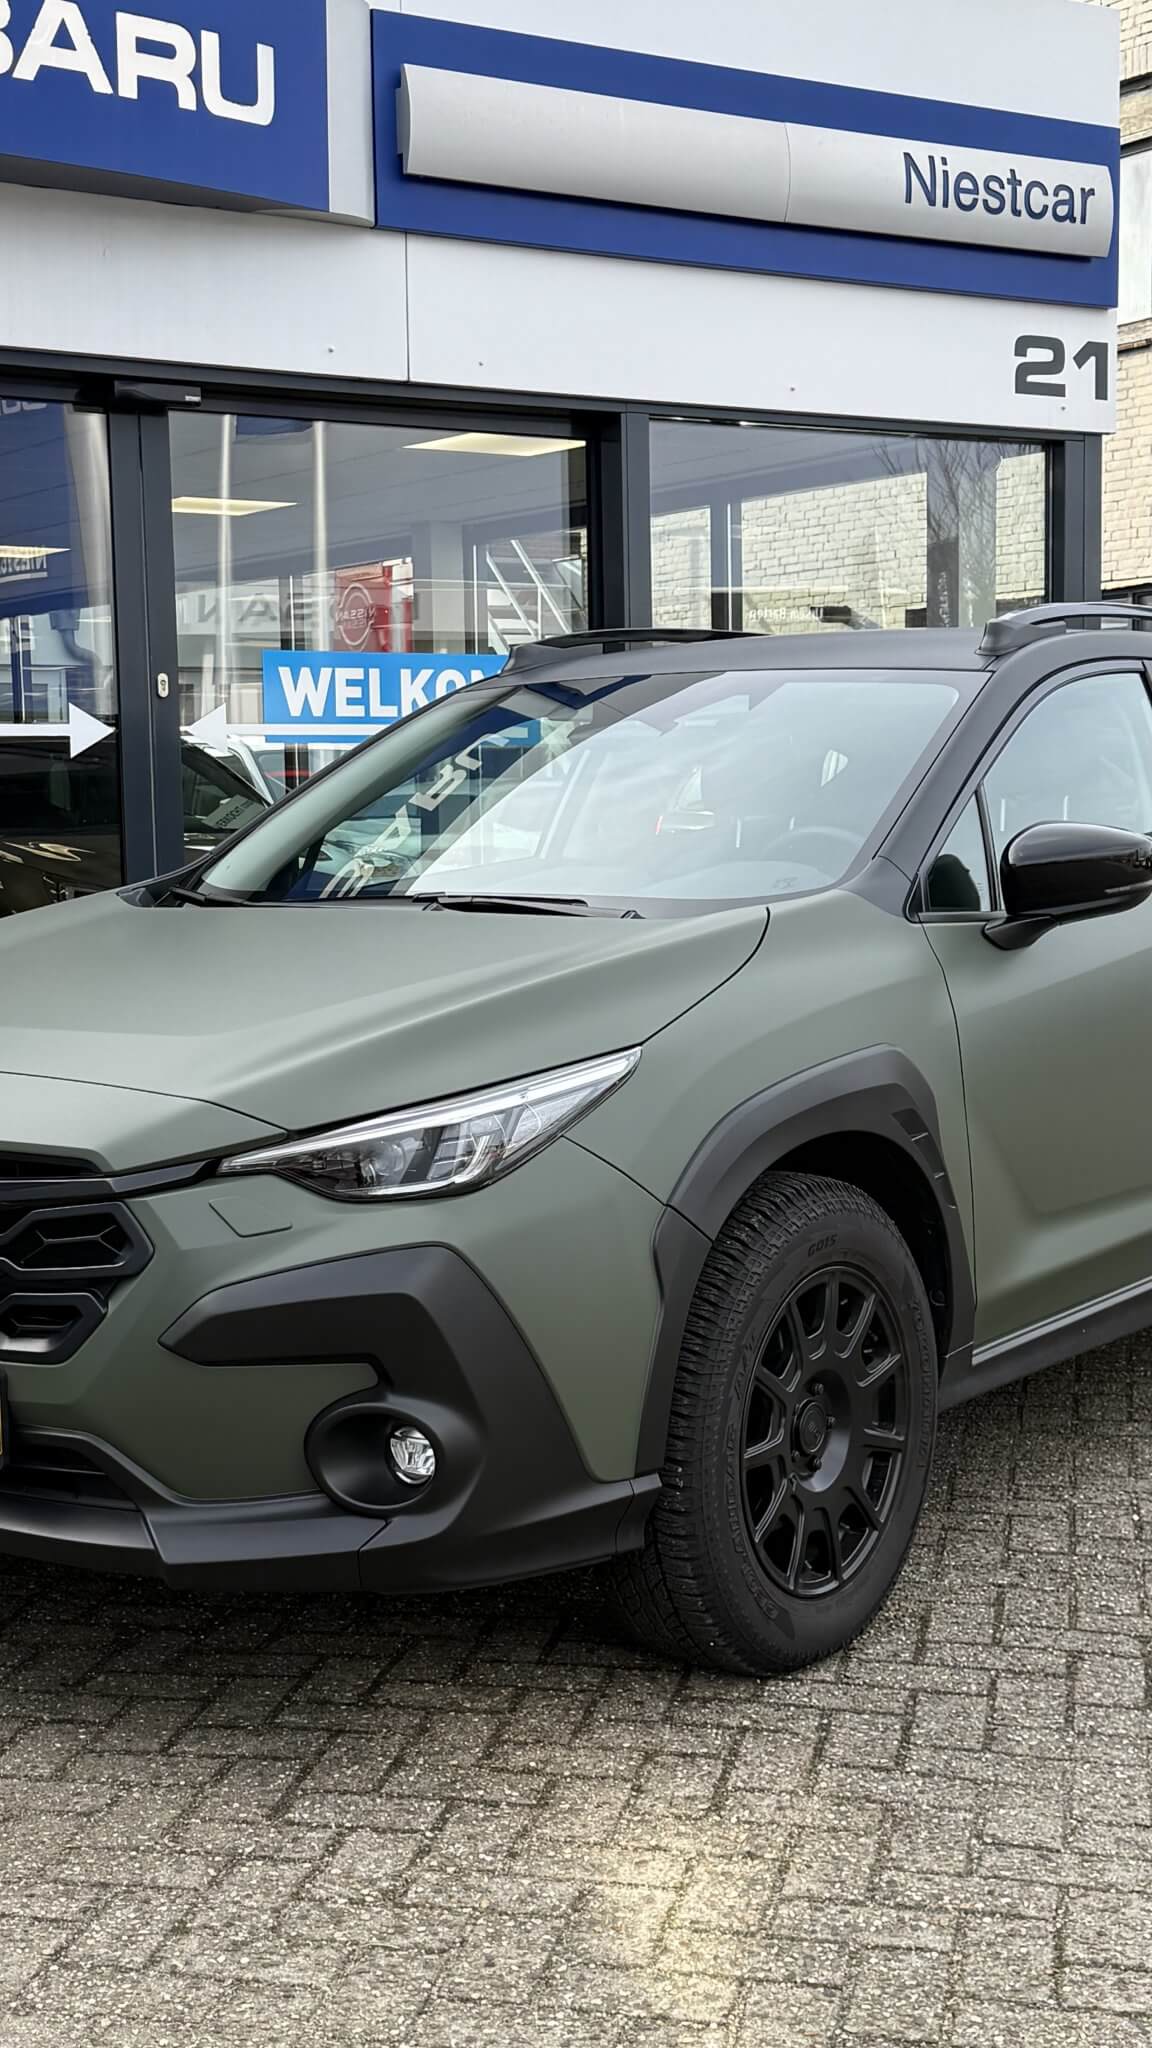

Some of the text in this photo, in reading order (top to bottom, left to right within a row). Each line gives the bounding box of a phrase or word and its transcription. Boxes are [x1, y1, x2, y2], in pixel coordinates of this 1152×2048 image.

[0, 0, 275, 126] ARU
[903, 152, 1096, 225] Niestcar
[1014, 334, 1109, 401] 21
